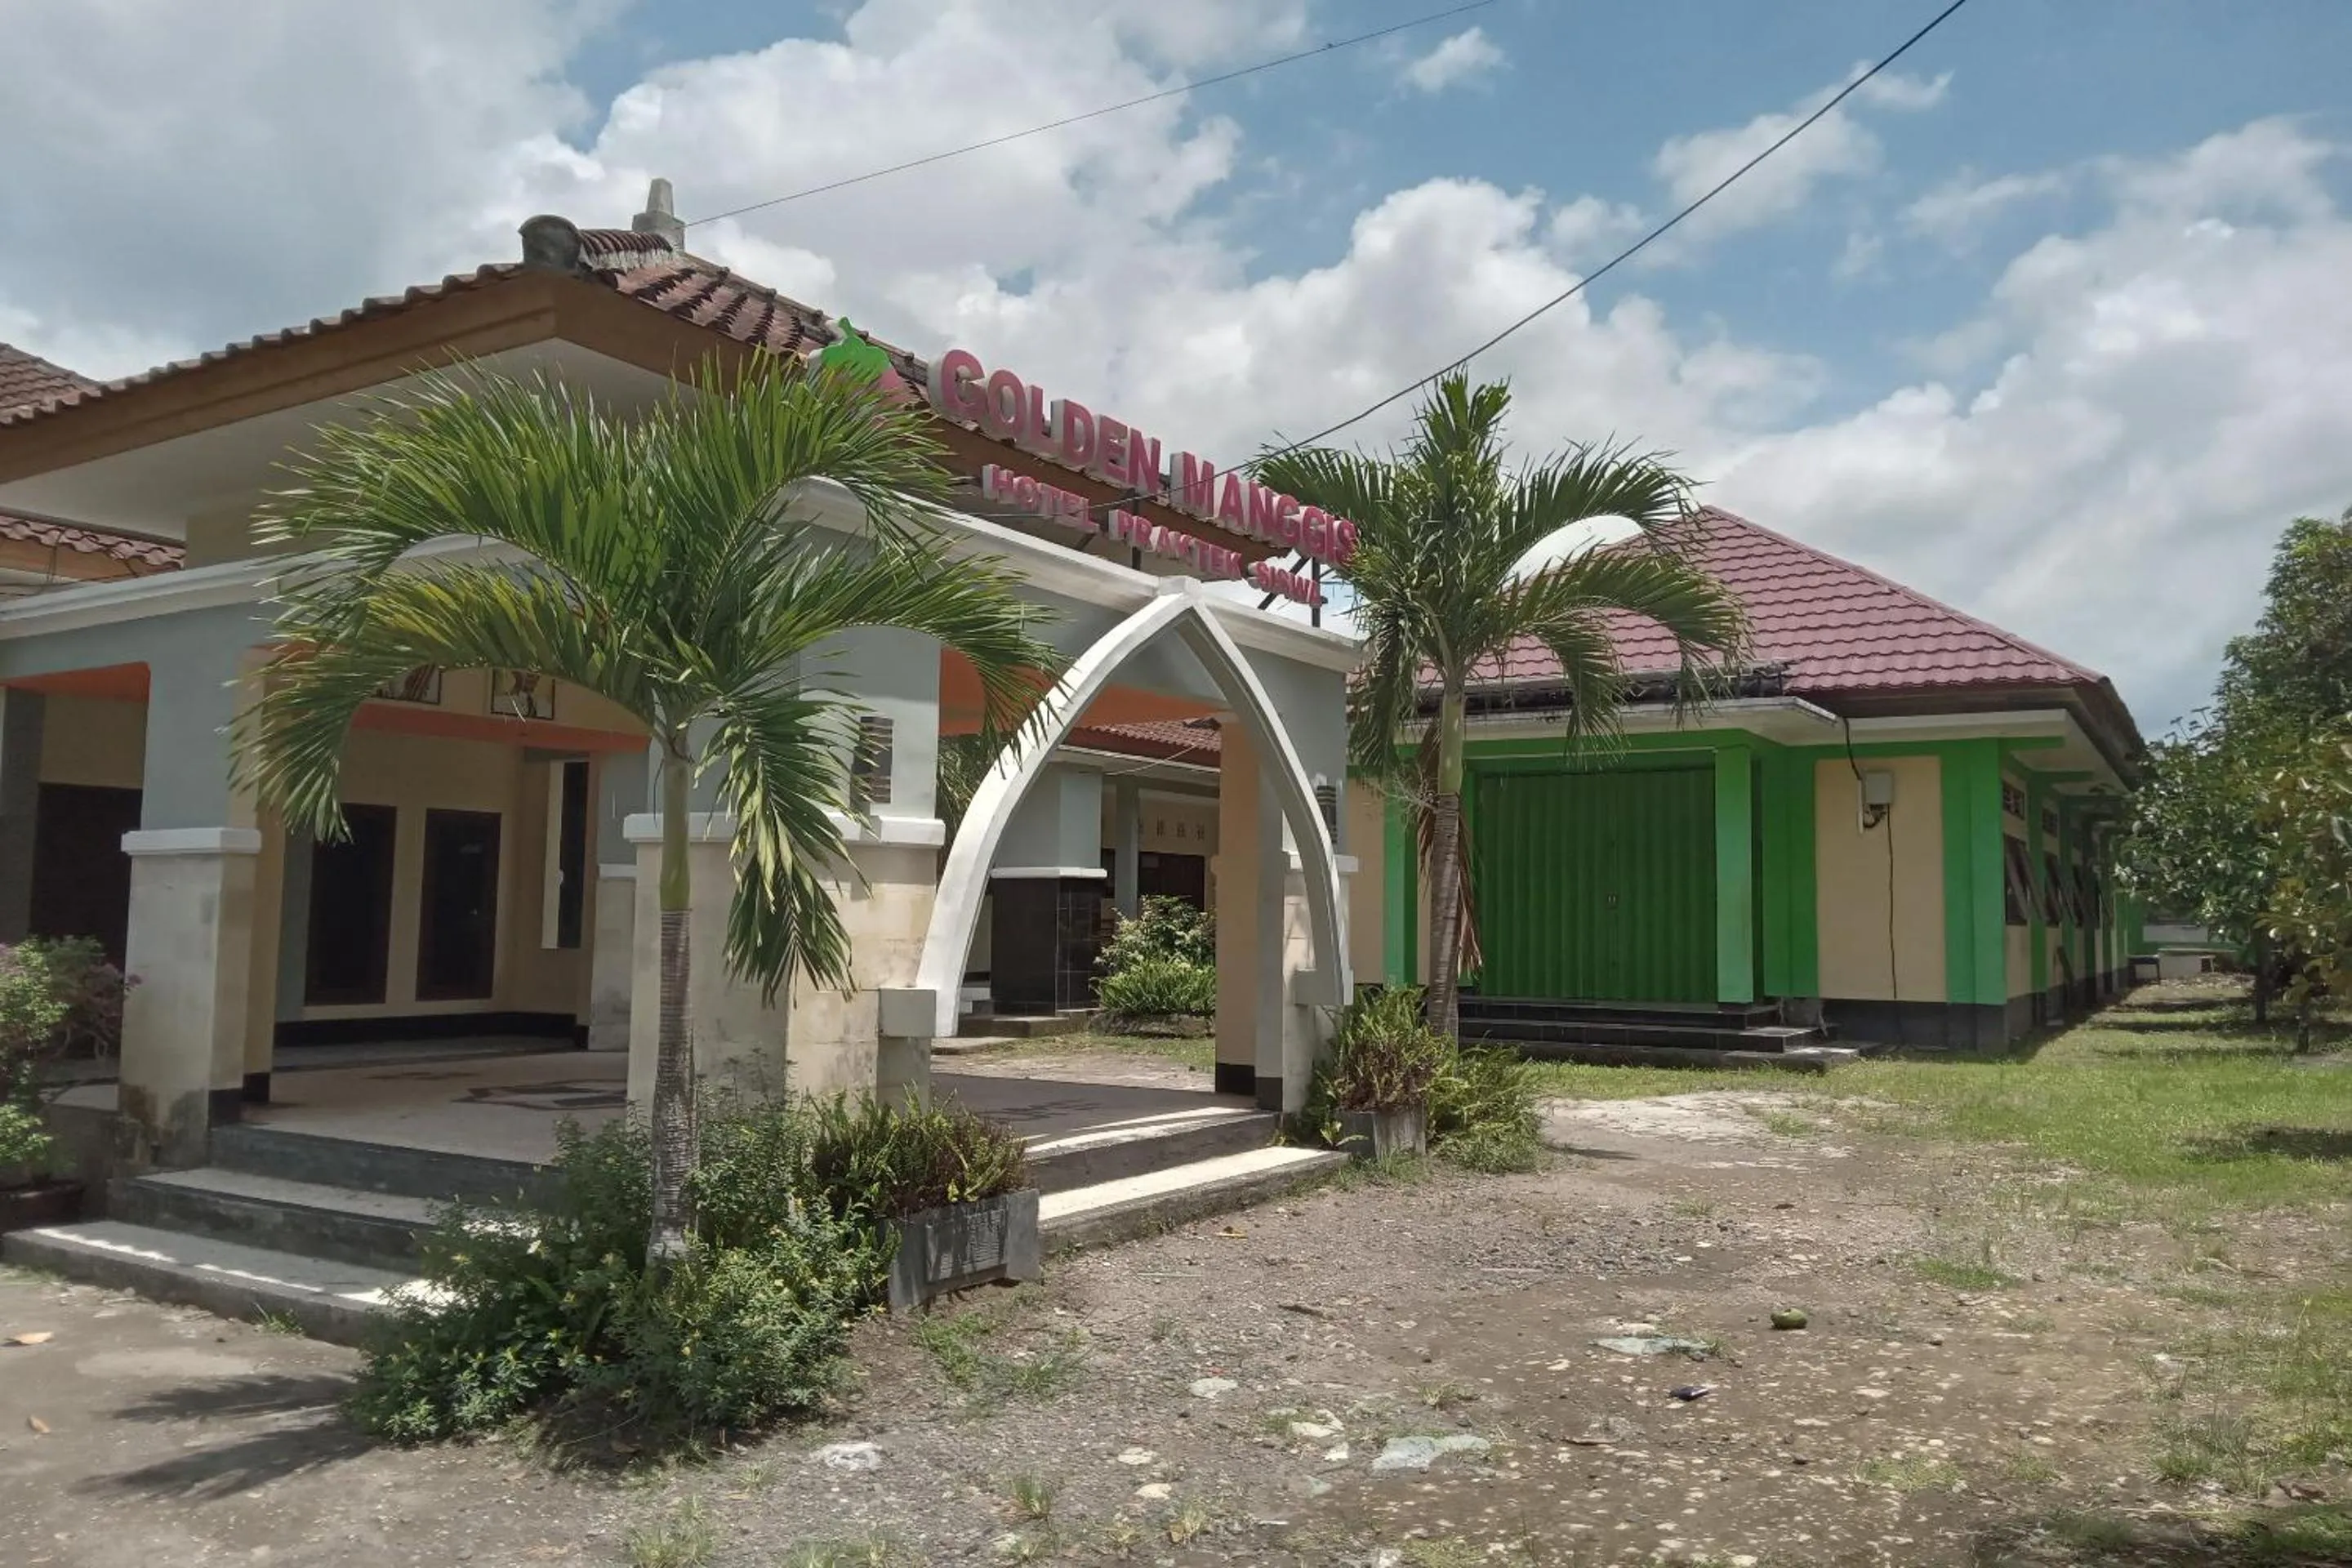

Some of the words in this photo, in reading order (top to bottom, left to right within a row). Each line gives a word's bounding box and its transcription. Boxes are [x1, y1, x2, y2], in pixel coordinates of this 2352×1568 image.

[931, 349, 1161, 495] GOLDEN
[1172, 451, 1359, 568] MANGGIS
[983, 464, 1099, 533] HOTEL
[1108, 509, 1242, 580] PRAKTEK
